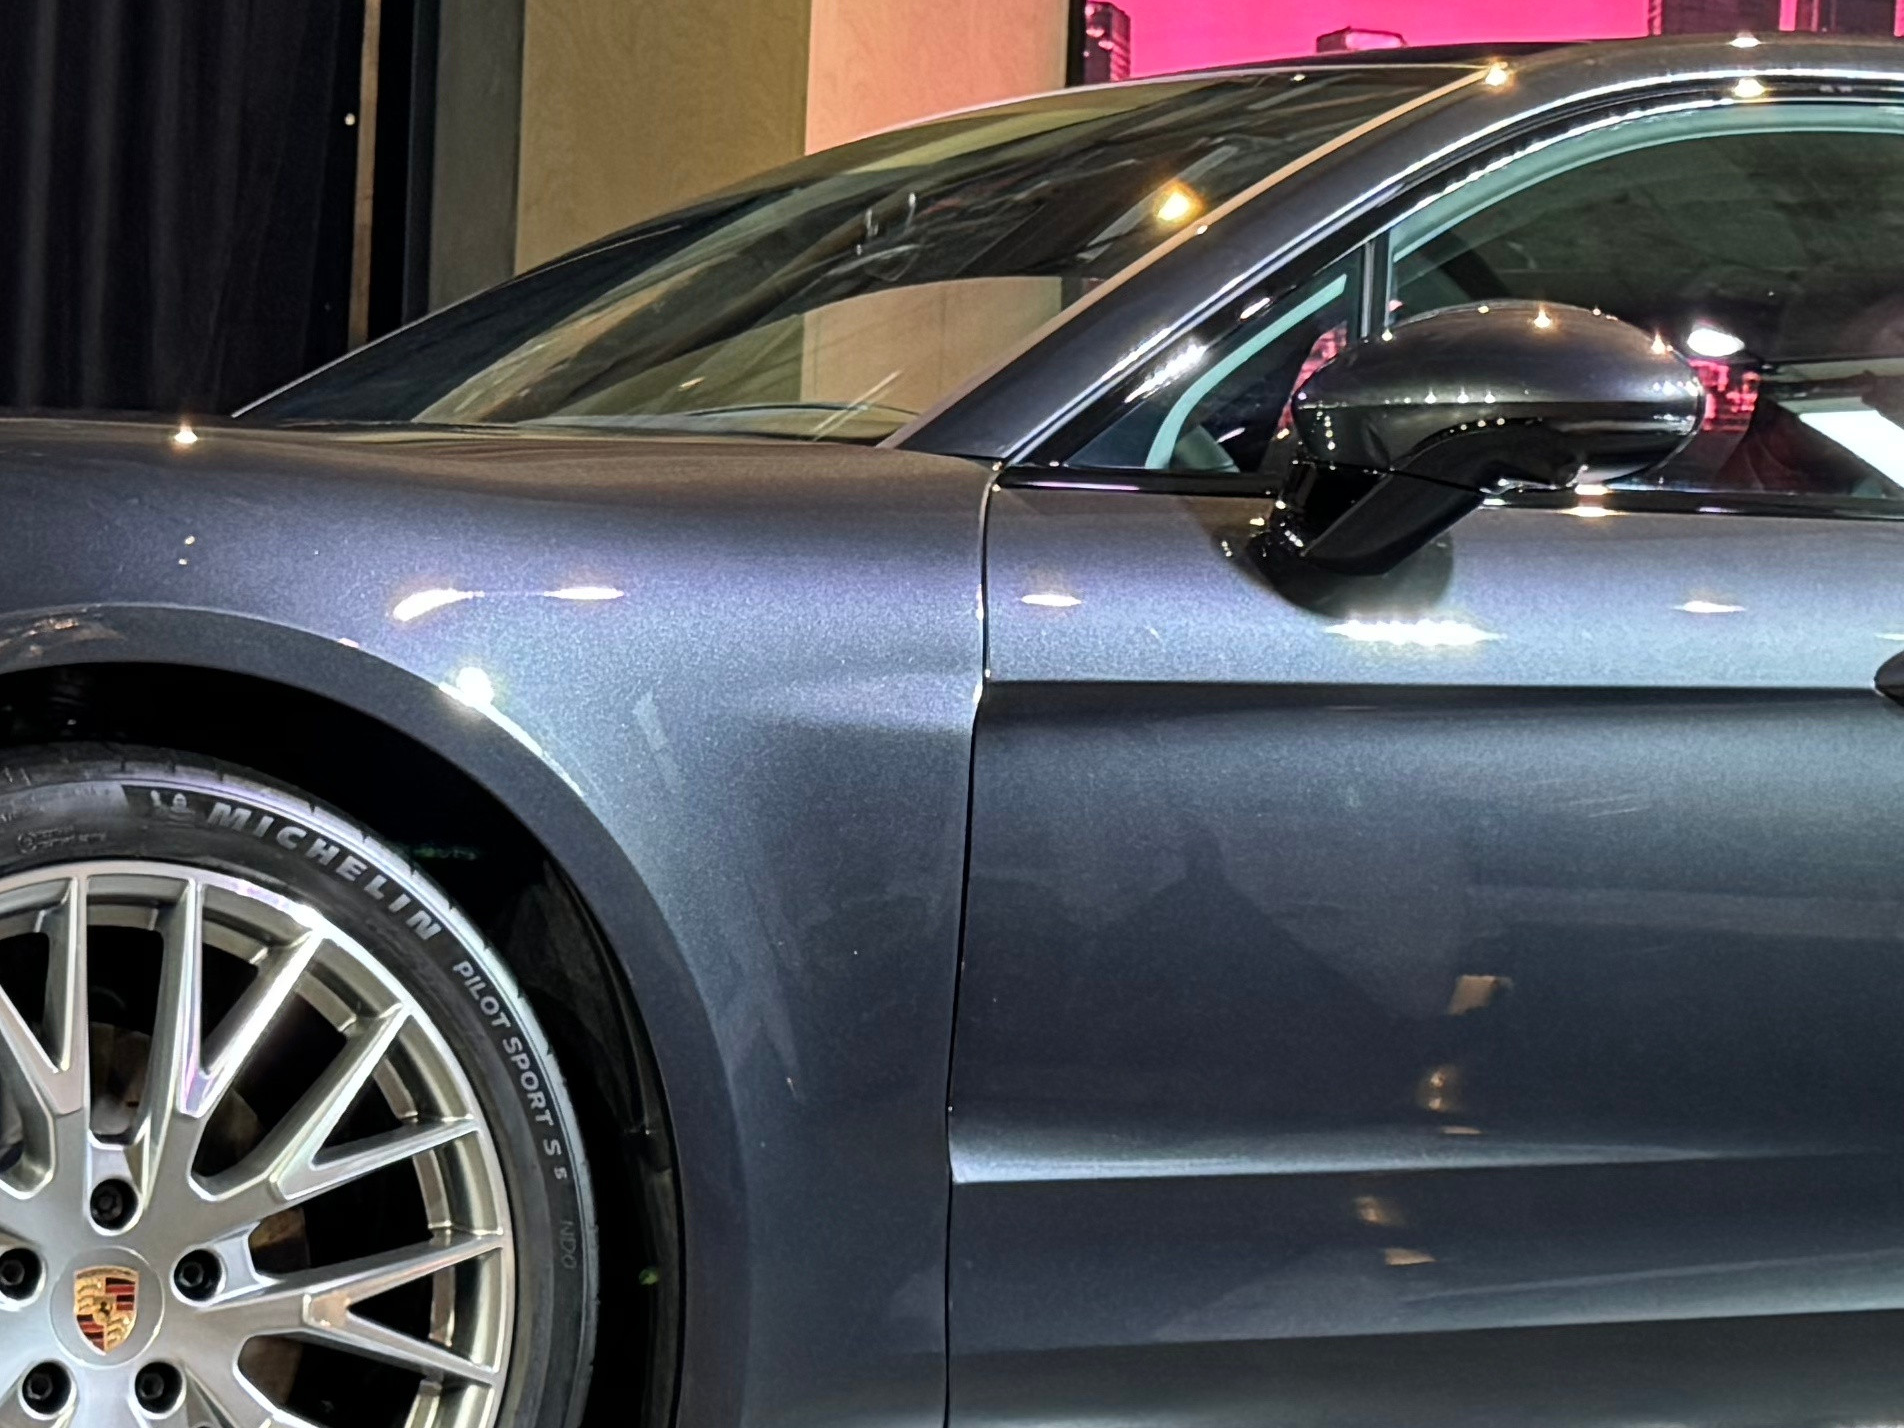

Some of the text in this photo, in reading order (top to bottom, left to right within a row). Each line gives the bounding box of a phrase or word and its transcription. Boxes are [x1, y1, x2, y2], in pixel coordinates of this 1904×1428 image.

[206, 801, 443, 942] MICHELIN
[453, 959, 512, 1029] PILOT
[502, 1036, 555, 1127] SPORT
[542, 1137, 562, 1158] S
